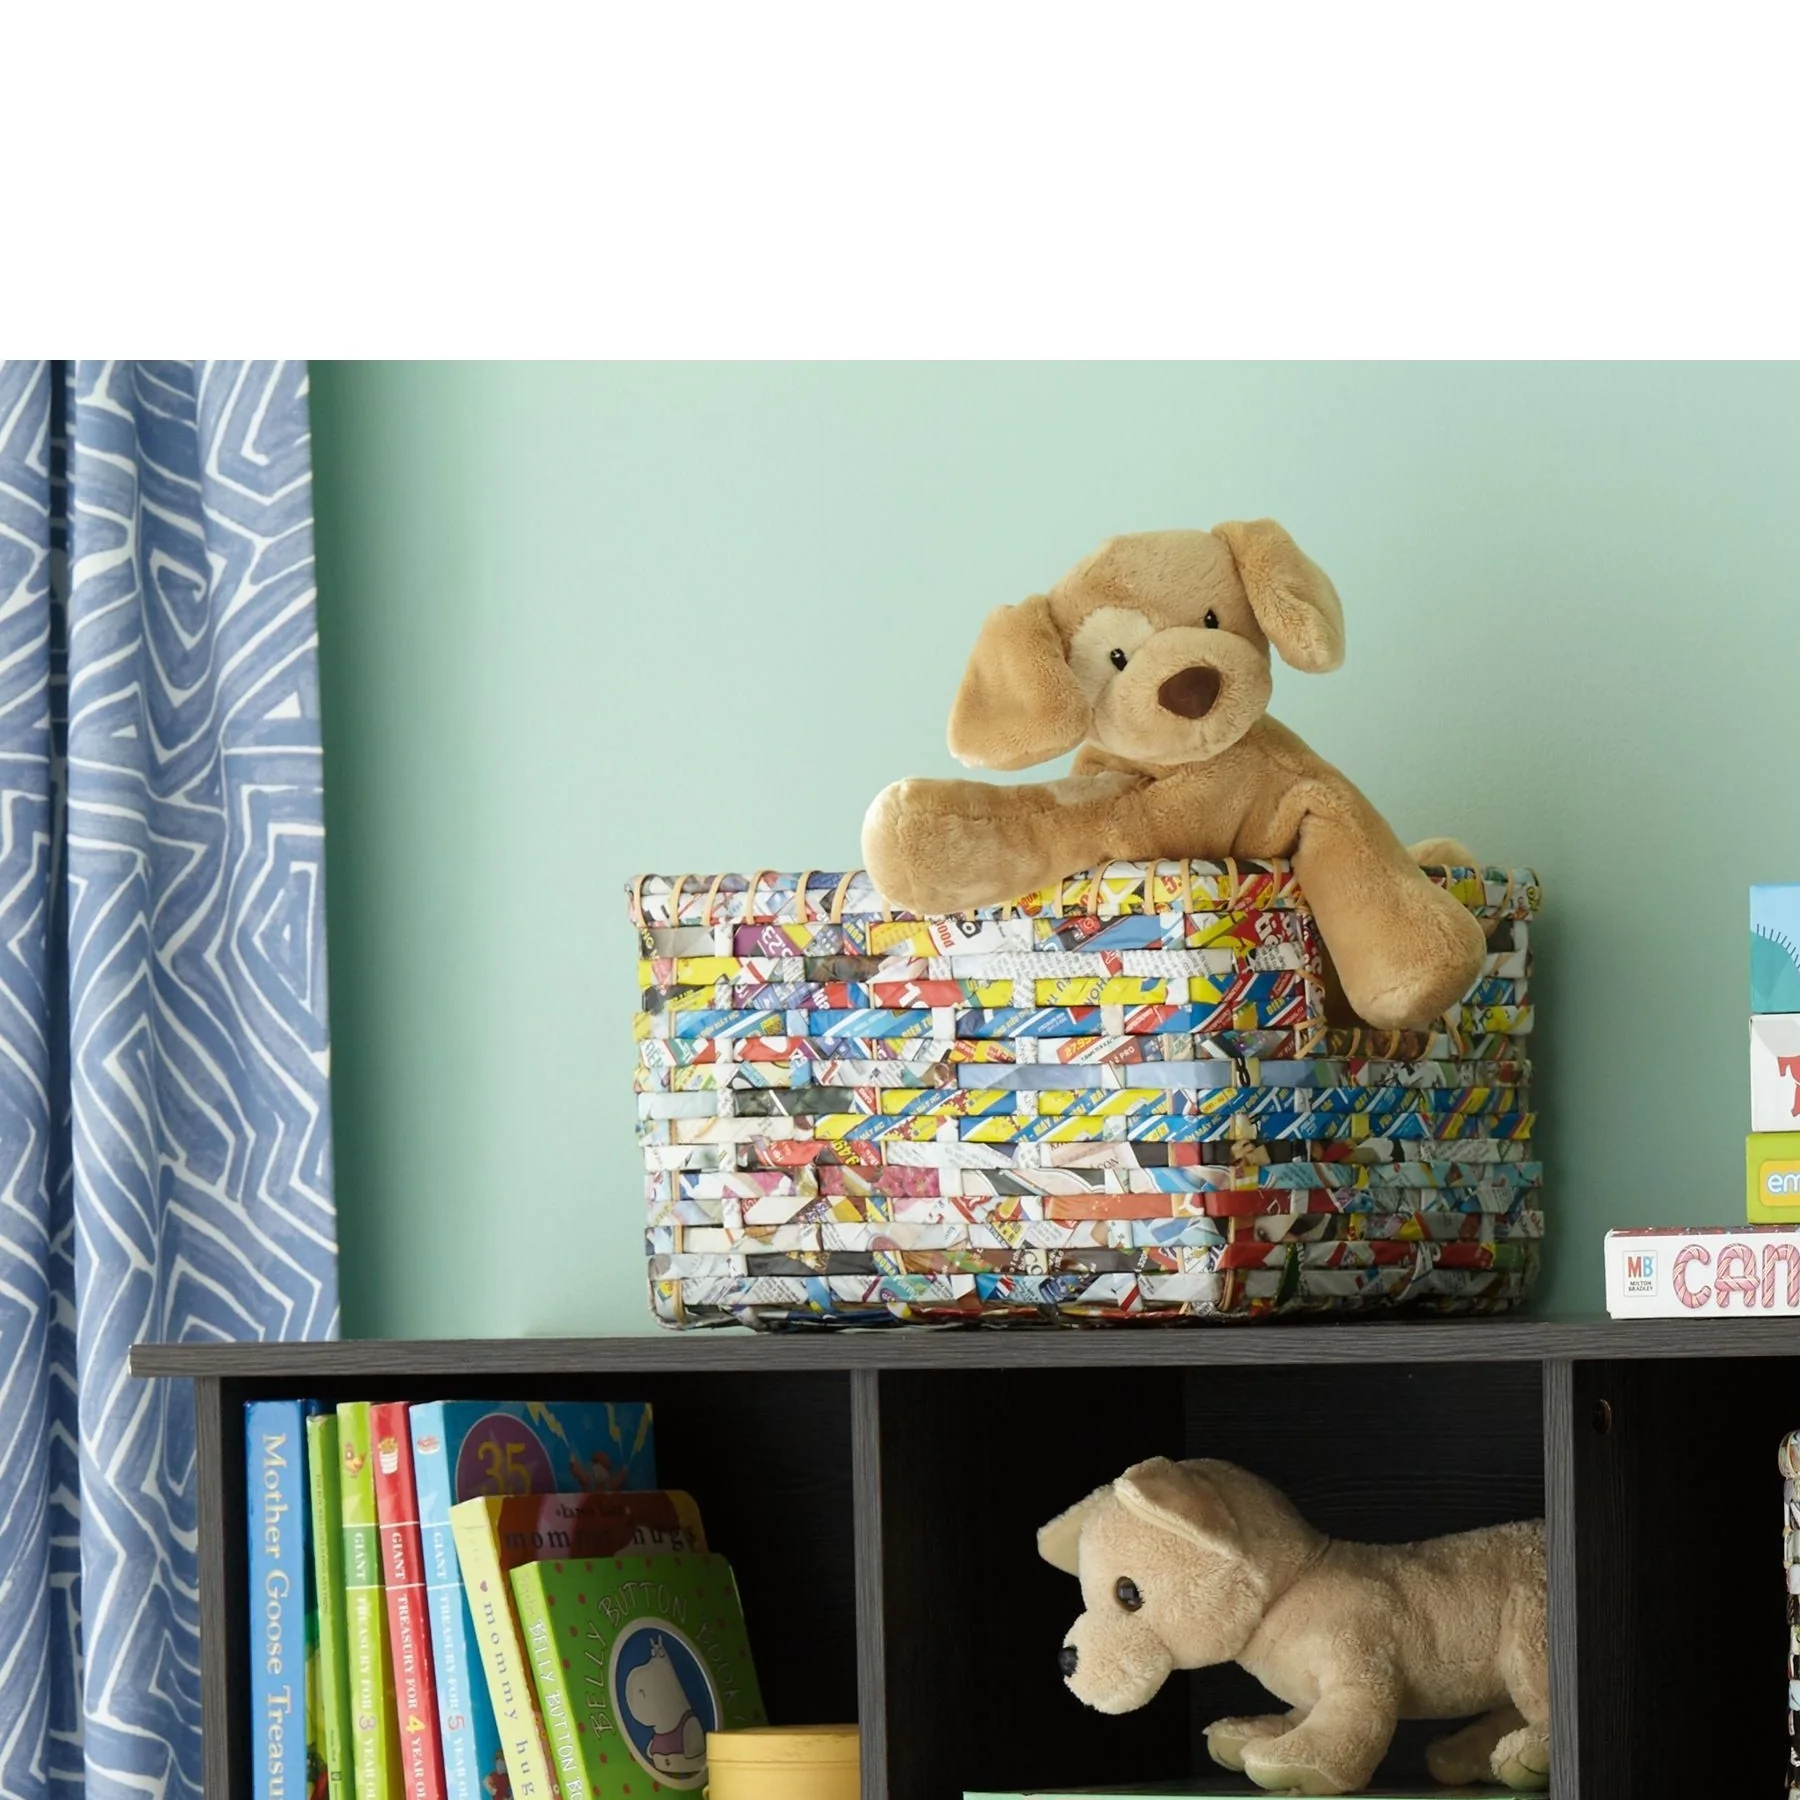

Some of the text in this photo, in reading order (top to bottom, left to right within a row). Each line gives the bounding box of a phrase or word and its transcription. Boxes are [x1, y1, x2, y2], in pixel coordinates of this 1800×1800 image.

[1627, 1255, 1654, 1278] MB
[477, 1441, 532, 1494] 35
[262, 1432, 290, 1559] Mother
[391, 1532, 406, 1580] GIANT
[265, 1569, 291, 1675] Goose
[397, 1594, 415, 1675] TREASURY
[483, 1602, 518, 1721] mommy
[403, 1678, 418, 1709] FOR
[528, 1618, 557, 1684] BELLY
[544, 1687, 578, 1774] BUTTON
[405, 1715, 425, 1734] 4
[411, 1736, 425, 1780] YEAR
